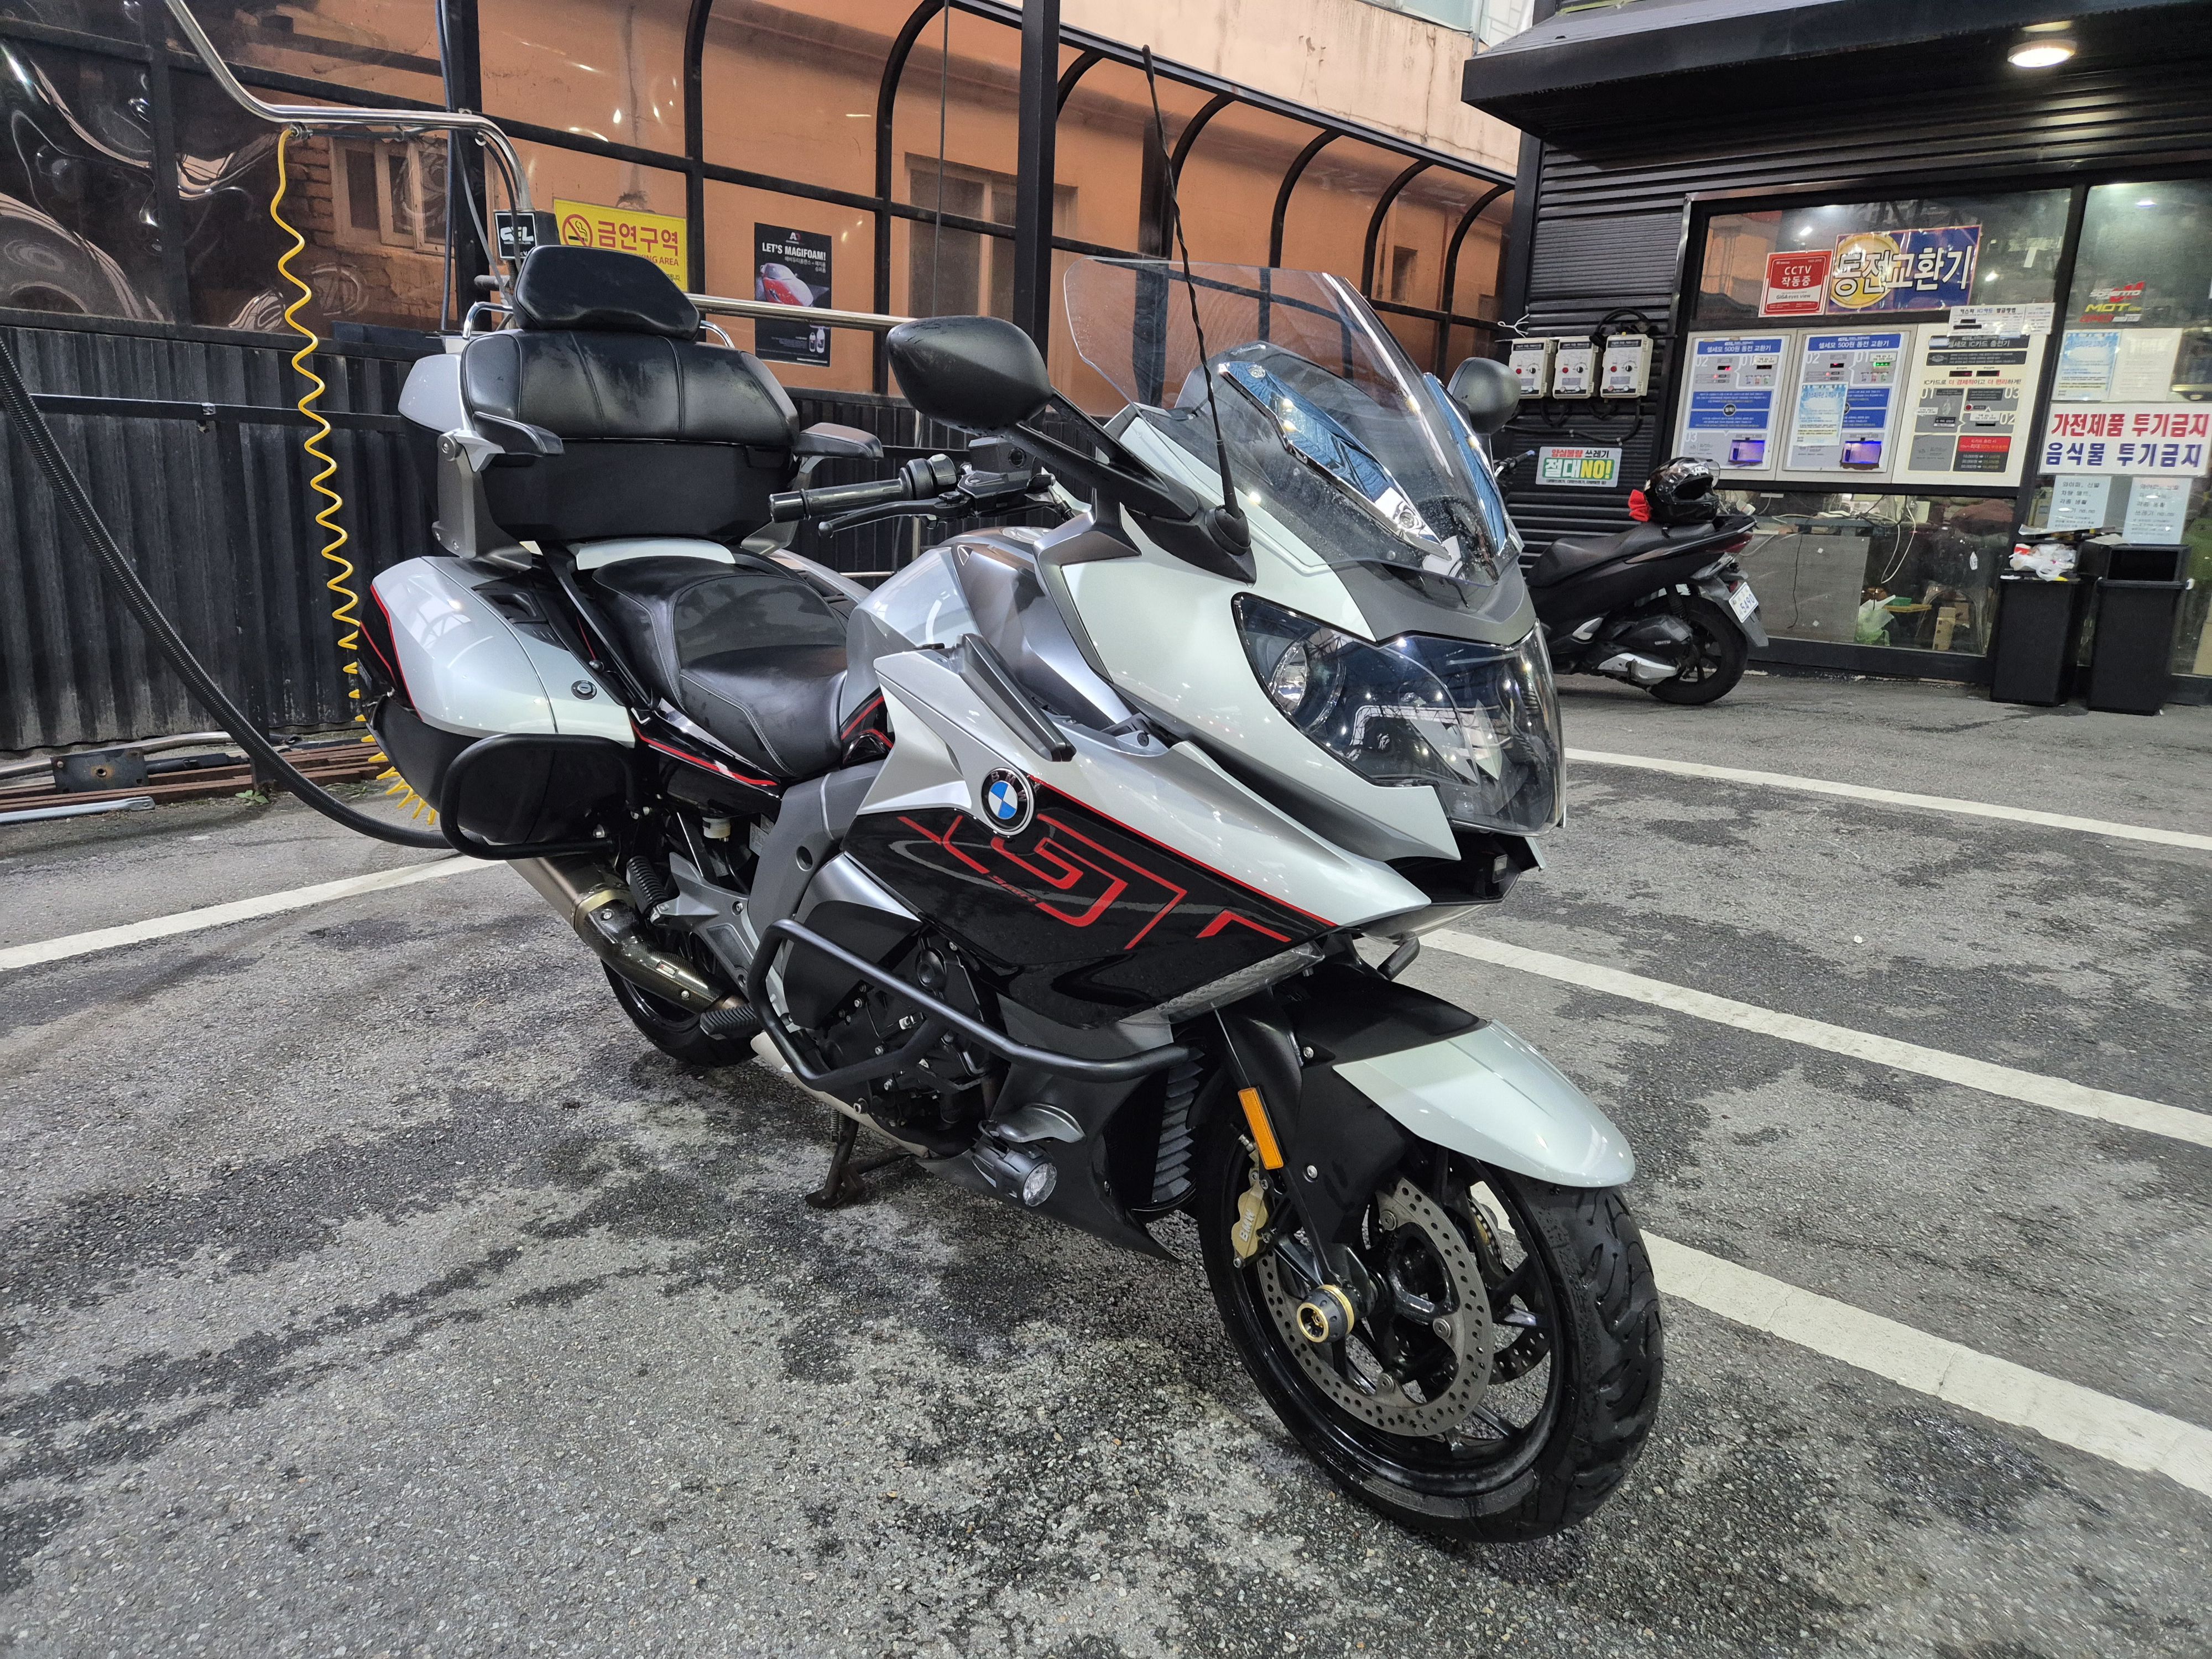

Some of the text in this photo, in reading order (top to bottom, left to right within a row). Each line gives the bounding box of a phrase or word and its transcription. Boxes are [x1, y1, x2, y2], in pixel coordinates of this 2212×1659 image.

[598, 220, 679, 257] 금연구역
[762, 242, 826, 260] LET'S MAGIFOAM!
[659, 256, 679, 266] AREA
[1785, 265, 1812, 275] CCTV
[1834, 246, 1973, 296] 동전교환기
[1782, 276, 1811, 287] 작동중
[1696, 356, 1708, 367] 02
[1806, 353, 1820, 363] 02
[1856, 351, 1869, 362] 01
[1922, 388, 1934, 399] 01
[2004, 388, 2019, 399] 03
[2000, 414, 2015, 425] 02
[2051, 414, 2209, 437] 가전제품 투기금지
[1686, 432, 1698, 442] 03
[1551, 449, 1609, 458] 양심불량 쓰레기
[2046, 442, 2202, 467] 음식물 투기금지
[1545, 458, 1612, 479] 절대NO!
[990, 771, 1027, 802] BMW
[1239, 1208, 1255, 1243] BMW
